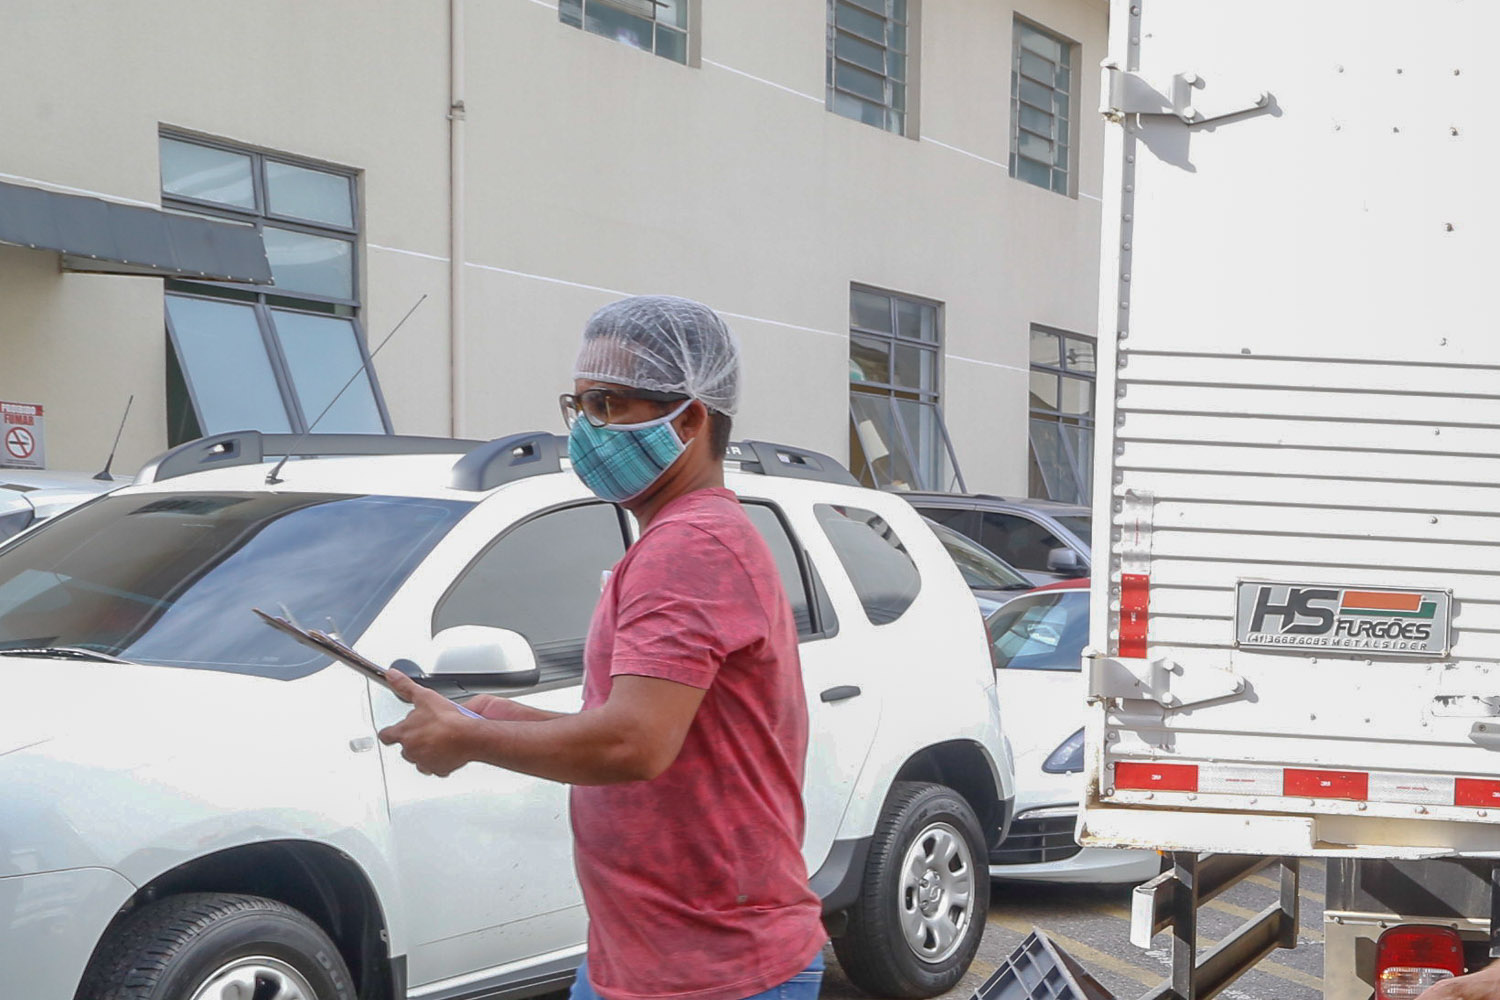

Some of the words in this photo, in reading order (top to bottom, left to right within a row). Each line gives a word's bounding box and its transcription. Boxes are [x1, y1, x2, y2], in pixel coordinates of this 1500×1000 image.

[1250, 586, 1339, 634] HS
[1334, 617, 1431, 640] FURGÕES
[1332, 639, 1427, 650] METALSIDER
